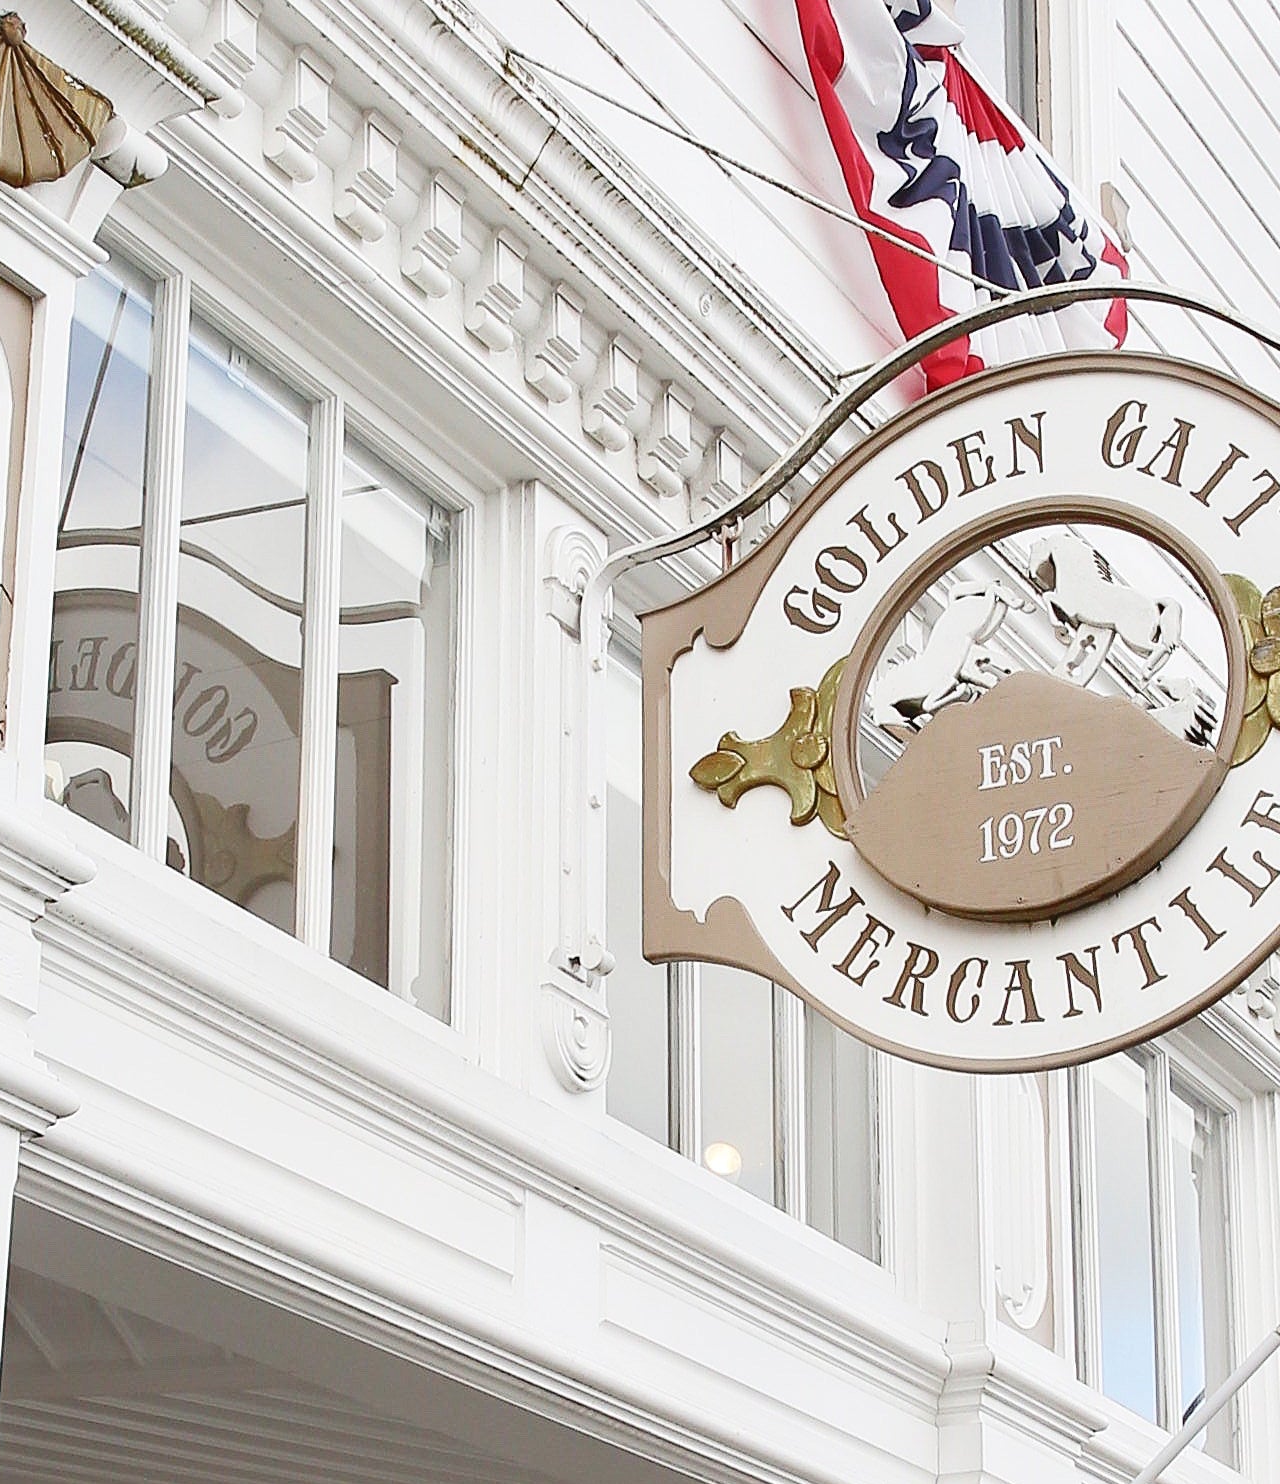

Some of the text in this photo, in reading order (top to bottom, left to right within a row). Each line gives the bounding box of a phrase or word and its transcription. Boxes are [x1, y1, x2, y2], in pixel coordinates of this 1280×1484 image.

[782, 410, 1048, 637] GOLDEN
[977, 735, 1073, 793] EST.
[977, 802, 1075, 864] 1972
